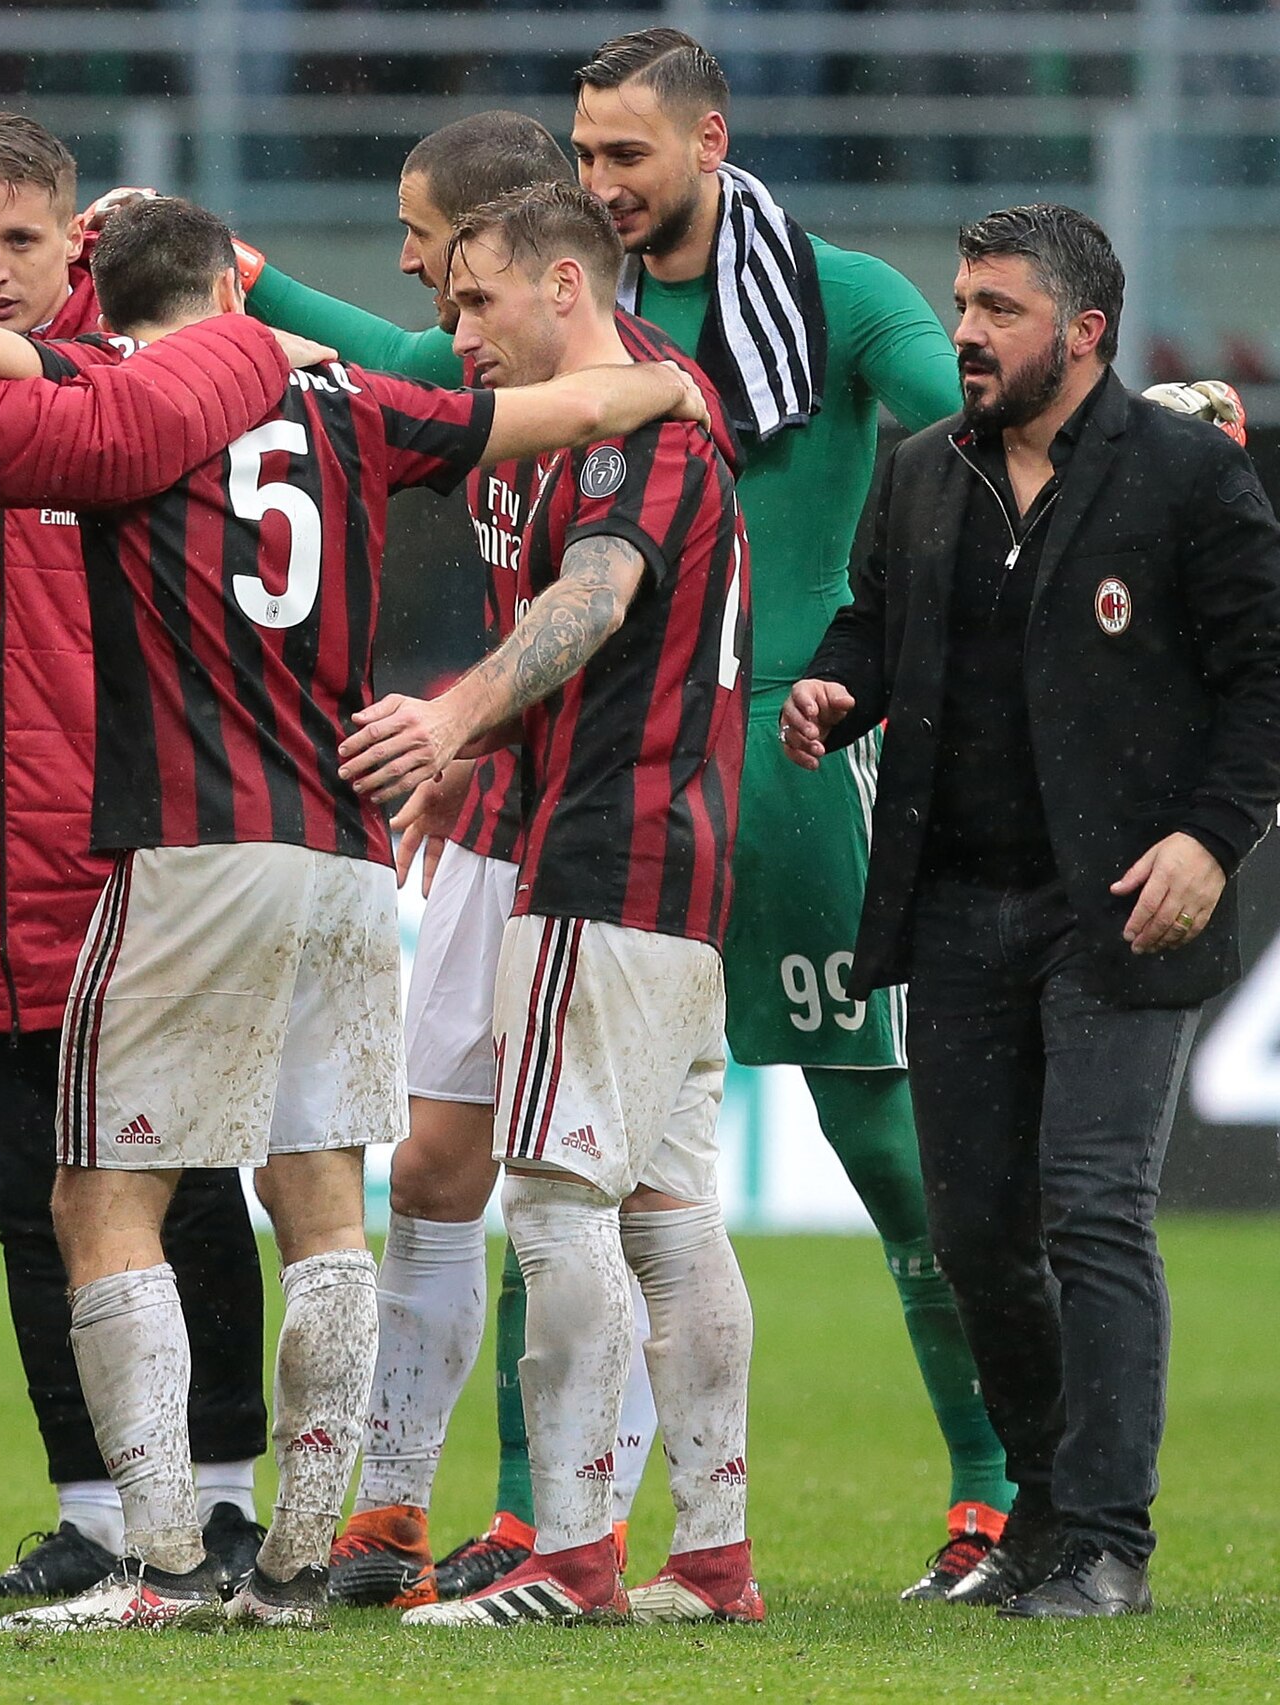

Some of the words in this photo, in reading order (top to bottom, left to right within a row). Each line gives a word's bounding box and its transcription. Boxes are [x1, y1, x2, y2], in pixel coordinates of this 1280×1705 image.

[596, 470, 607, 484] 7
[40, 508, 79, 526] Emir
[487, 475, 521, 527] Fly
[229, 419, 323, 629] 5
[468, 504, 522, 572] mira
[780, 950, 867, 1032] 99
[115, 1133, 162, 1145] adidas
[561, 1136, 602, 1160] adidas
